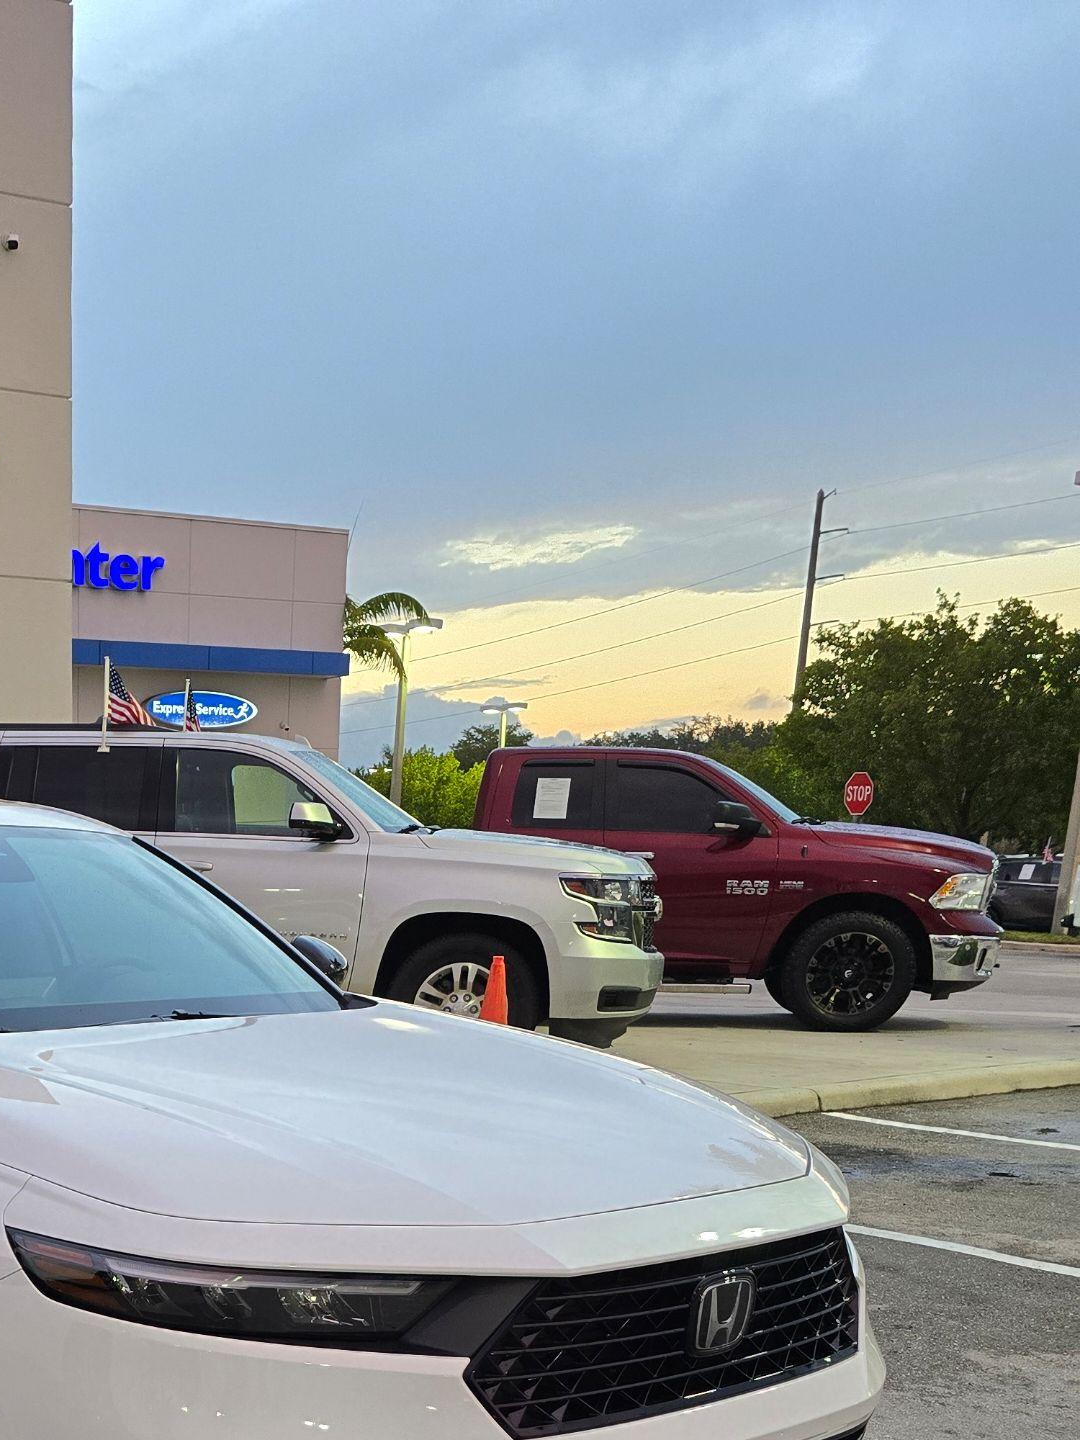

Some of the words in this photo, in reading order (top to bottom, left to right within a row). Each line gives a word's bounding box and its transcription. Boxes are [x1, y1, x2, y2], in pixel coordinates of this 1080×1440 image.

[196, 703, 234, 716] Service
[846, 785, 872, 802] STOP
[726, 879, 770, 888] RAM
[726, 887, 769, 896] 1500
